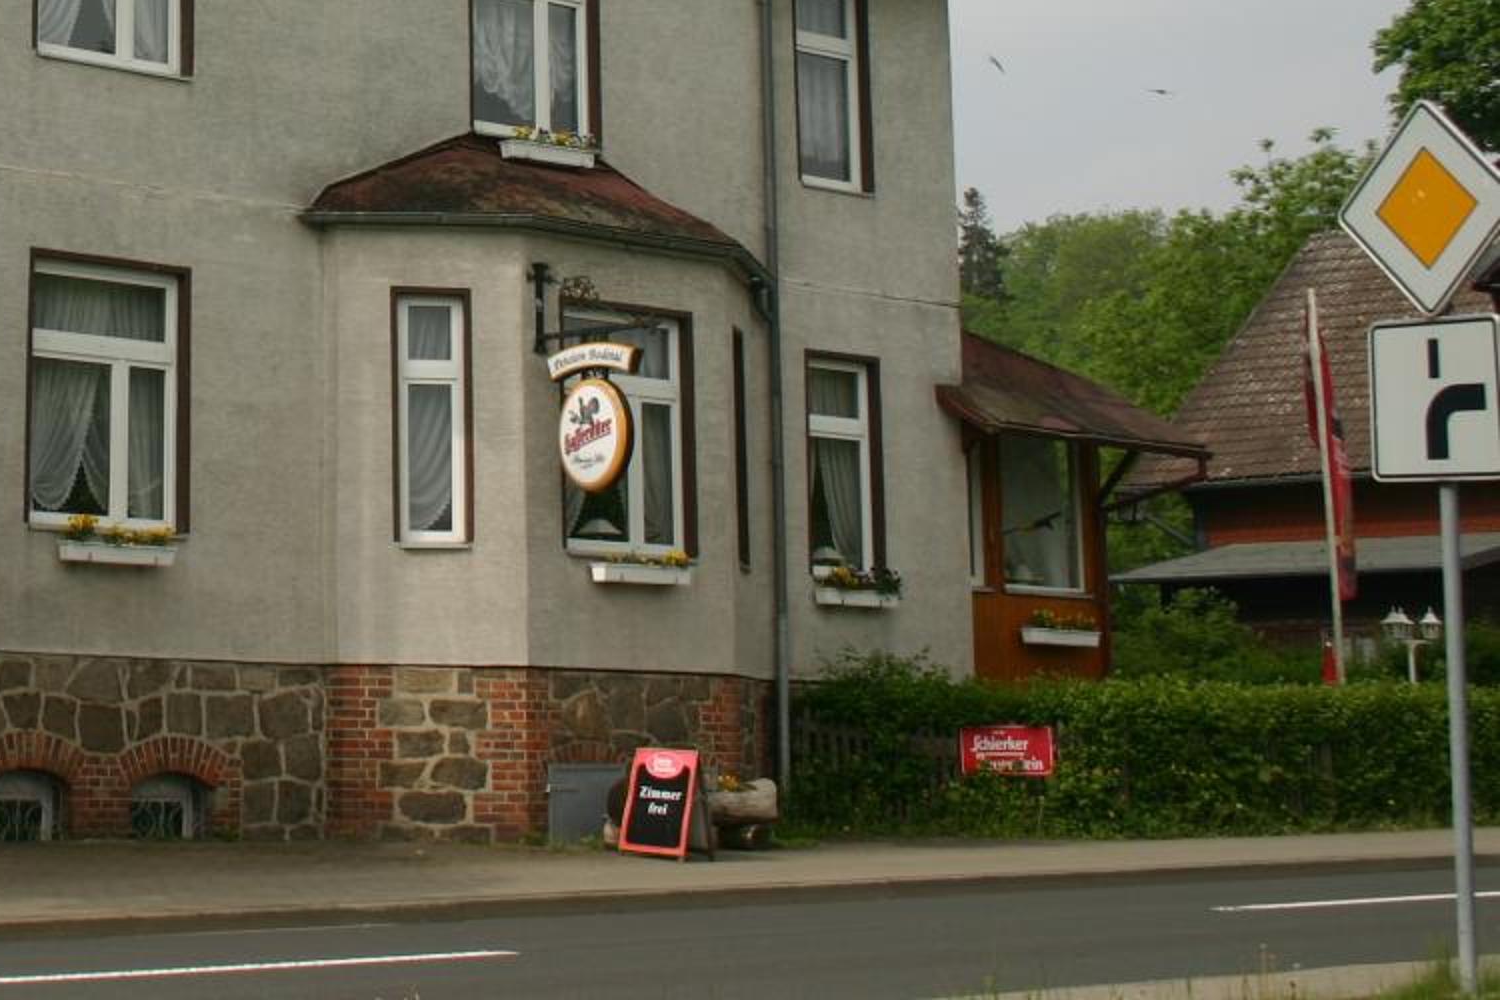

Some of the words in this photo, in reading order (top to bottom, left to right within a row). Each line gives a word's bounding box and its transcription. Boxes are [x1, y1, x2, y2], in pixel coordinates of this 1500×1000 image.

[969, 734, 1029, 753] Schierker
[639, 785, 682, 801] Zimmer
[647, 801, 669, 816] frei
